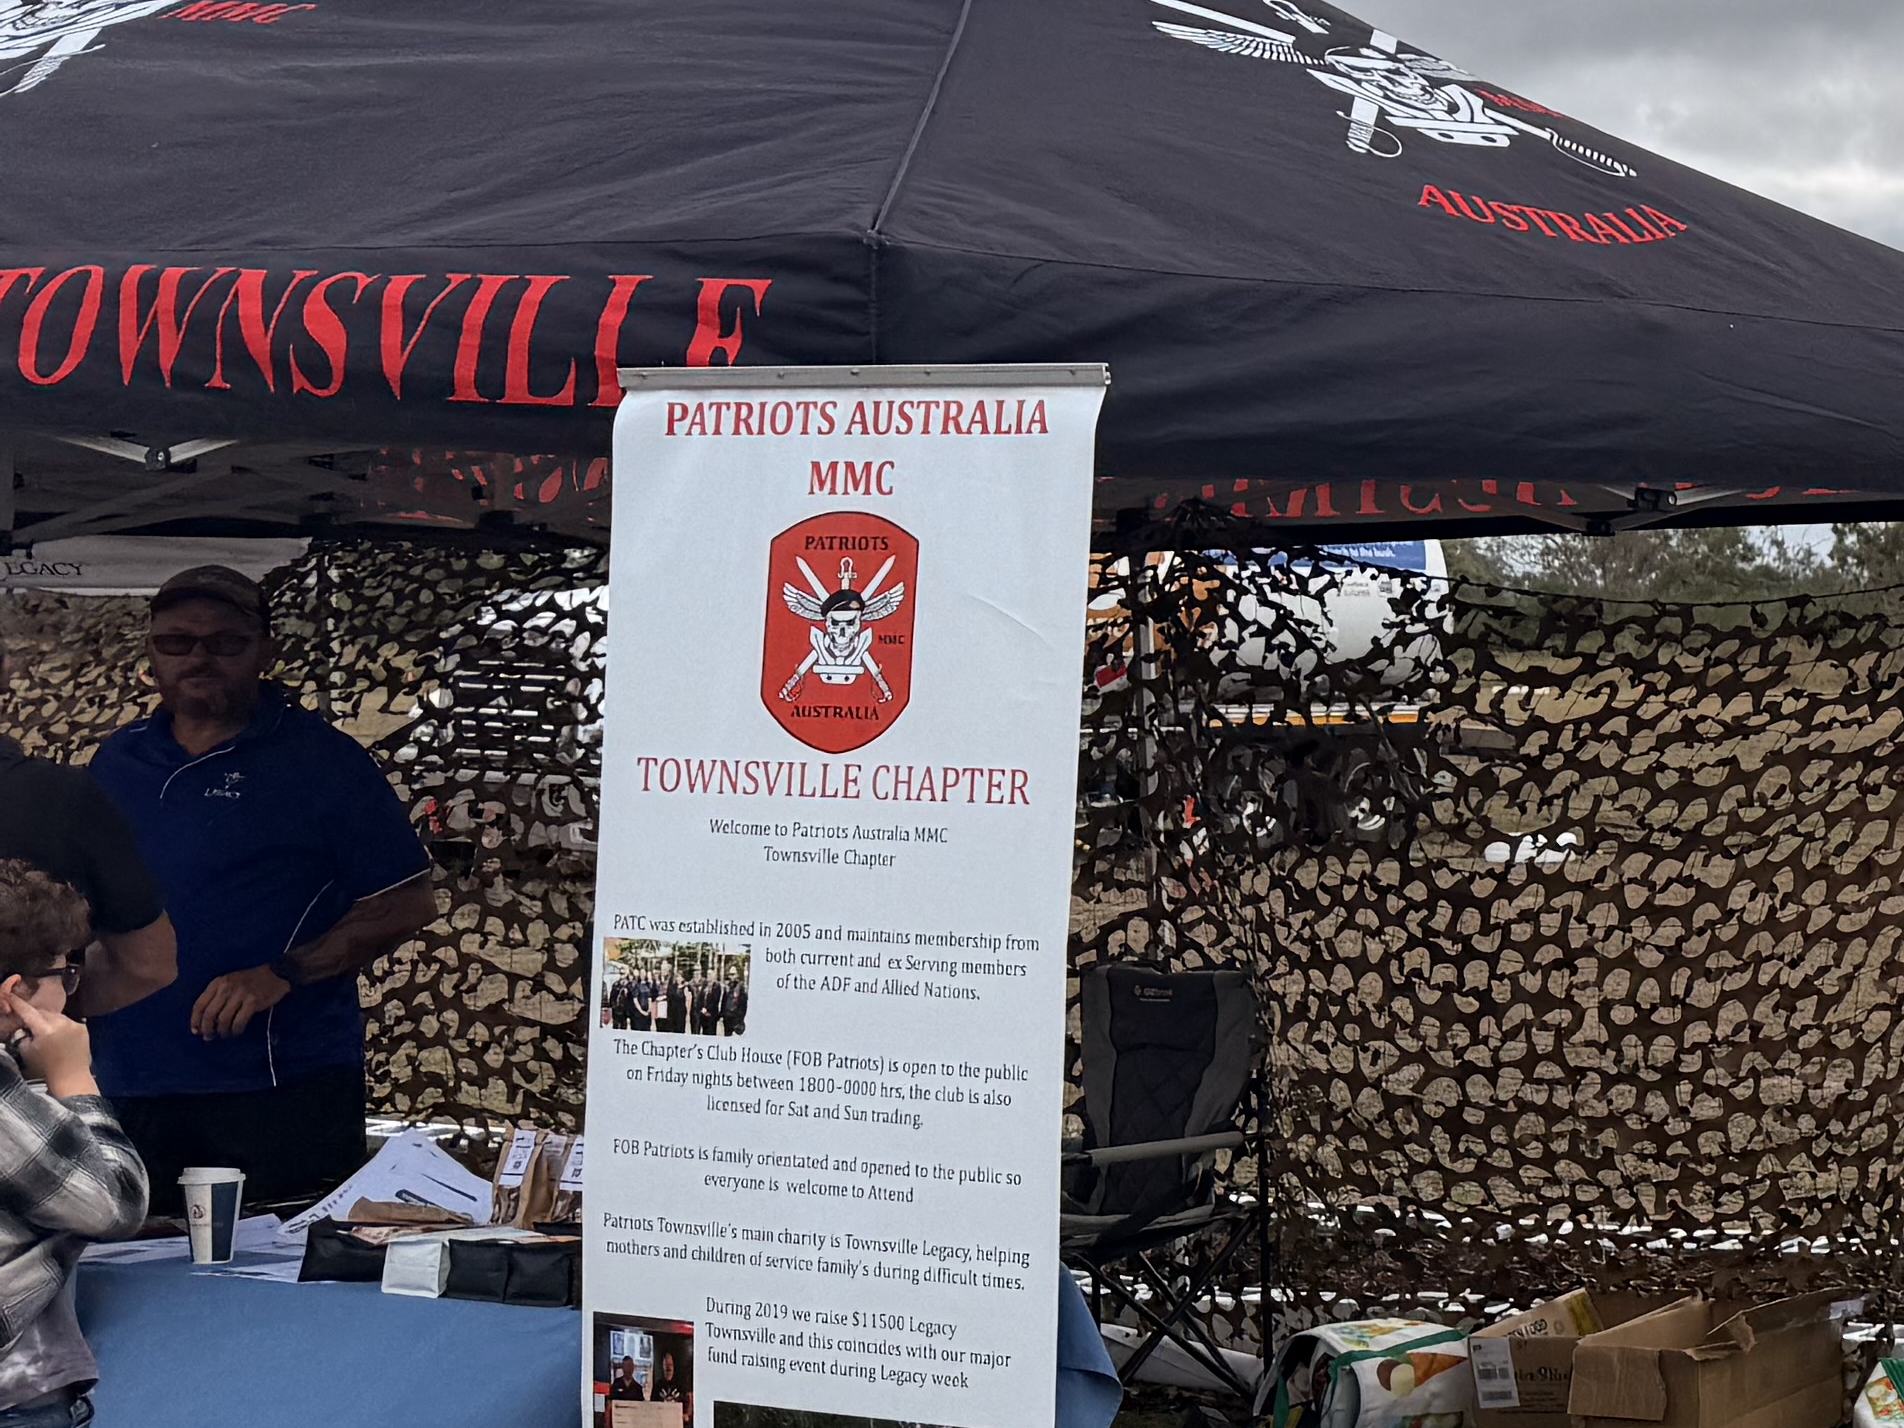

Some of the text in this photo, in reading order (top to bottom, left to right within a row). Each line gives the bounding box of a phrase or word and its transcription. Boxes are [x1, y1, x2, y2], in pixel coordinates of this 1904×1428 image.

[1417, 184, 1689, 245] AUSTRALIA
[664, 398, 1049, 437] PATRIOTS AUSTRALIA
[807, 460, 895, 496] MMC
[804, 535, 889, 551] PATRIOTS
[878, 634, 905, 645] MMC
[790, 705, 879, 721] AUSTRALIA
[636, 757, 1030, 806] TOWNSVILLE CHAPTER
[709, 818, 949, 844] Welcome to Patriots Australia MMC
[763, 845, 897, 871] Townsville Chapter
[613, 913, 1040, 954] PATC was established in 2005 and maintains membership from
[765, 946, 1028, 978] both current and ex Serving members
[776, 972, 791, 991] of
[793, 973, 817, 991] the
[819, 975, 852, 994] ADF
[853, 977, 879, 995] and
[880, 978, 920, 997] Allied
[612, 1037, 1029, 1084] The Chapter's Club House (FOB Patriots) is open to the public
[626, 1068, 643, 1081] on
[646, 1065, 689, 1089] Friday
[691, 1069, 733, 1091] nights
[736, 1071, 794, 1092] between
[909, 1083, 932, 1102] the
[934, 1085, 965, 1104] club
[968, 1087, 980, 1105] is
[982, 1088, 1012, 1107] also
[706, 1093, 762, 1115] licensed
[765, 1098, 785, 1116] for
[787, 1100, 810, 1119] Sat
[812, 1103, 841, 1120] and
[843, 1104, 868, 1123] Sun
[613, 1137, 1022, 1187] FOB Patriots is family orientated and opened to the public so
[768, 1176, 780, 1193] is
[786, 1177, 849, 1198] welcome
[851, 1184, 865, 1199] to
[867, 1184, 914, 1204] Attend
[603, 1211, 654, 1233] Patriots
[656, 1216, 738, 1240] Townsville's
[741, 1228, 774, 1244] main
[777, 1227, 828, 1251] charity
[830, 1233, 842, 1249] is
[844, 1233, 919, 1255] Townsville
[976, 1243, 1031, 1270] helping
[606, 1238, 661, 1258] mothers
[662, 1243, 688, 1260] and
[690, 1244, 746, 1267] children
[749, 1250, 763, 1267] of
[765, 1254, 814, 1272] service
[817, 1255, 870, 1280] family's
[872, 1260, 920, 1286] during
[923, 1266, 978, 1287] difficult
[706, 1296, 752, 1322] During
[755, 1301, 789, 1320] 2019
[791, 1308, 811, 1323] we
[815, 1309, 849, 1327] raise
[909, 1316, 958, 1341] Legacy
[704, 1321, 1012, 1370] Townsville and this coincides with our major
[707, 1345, 970, 1389] fund raising event during Legacy week
